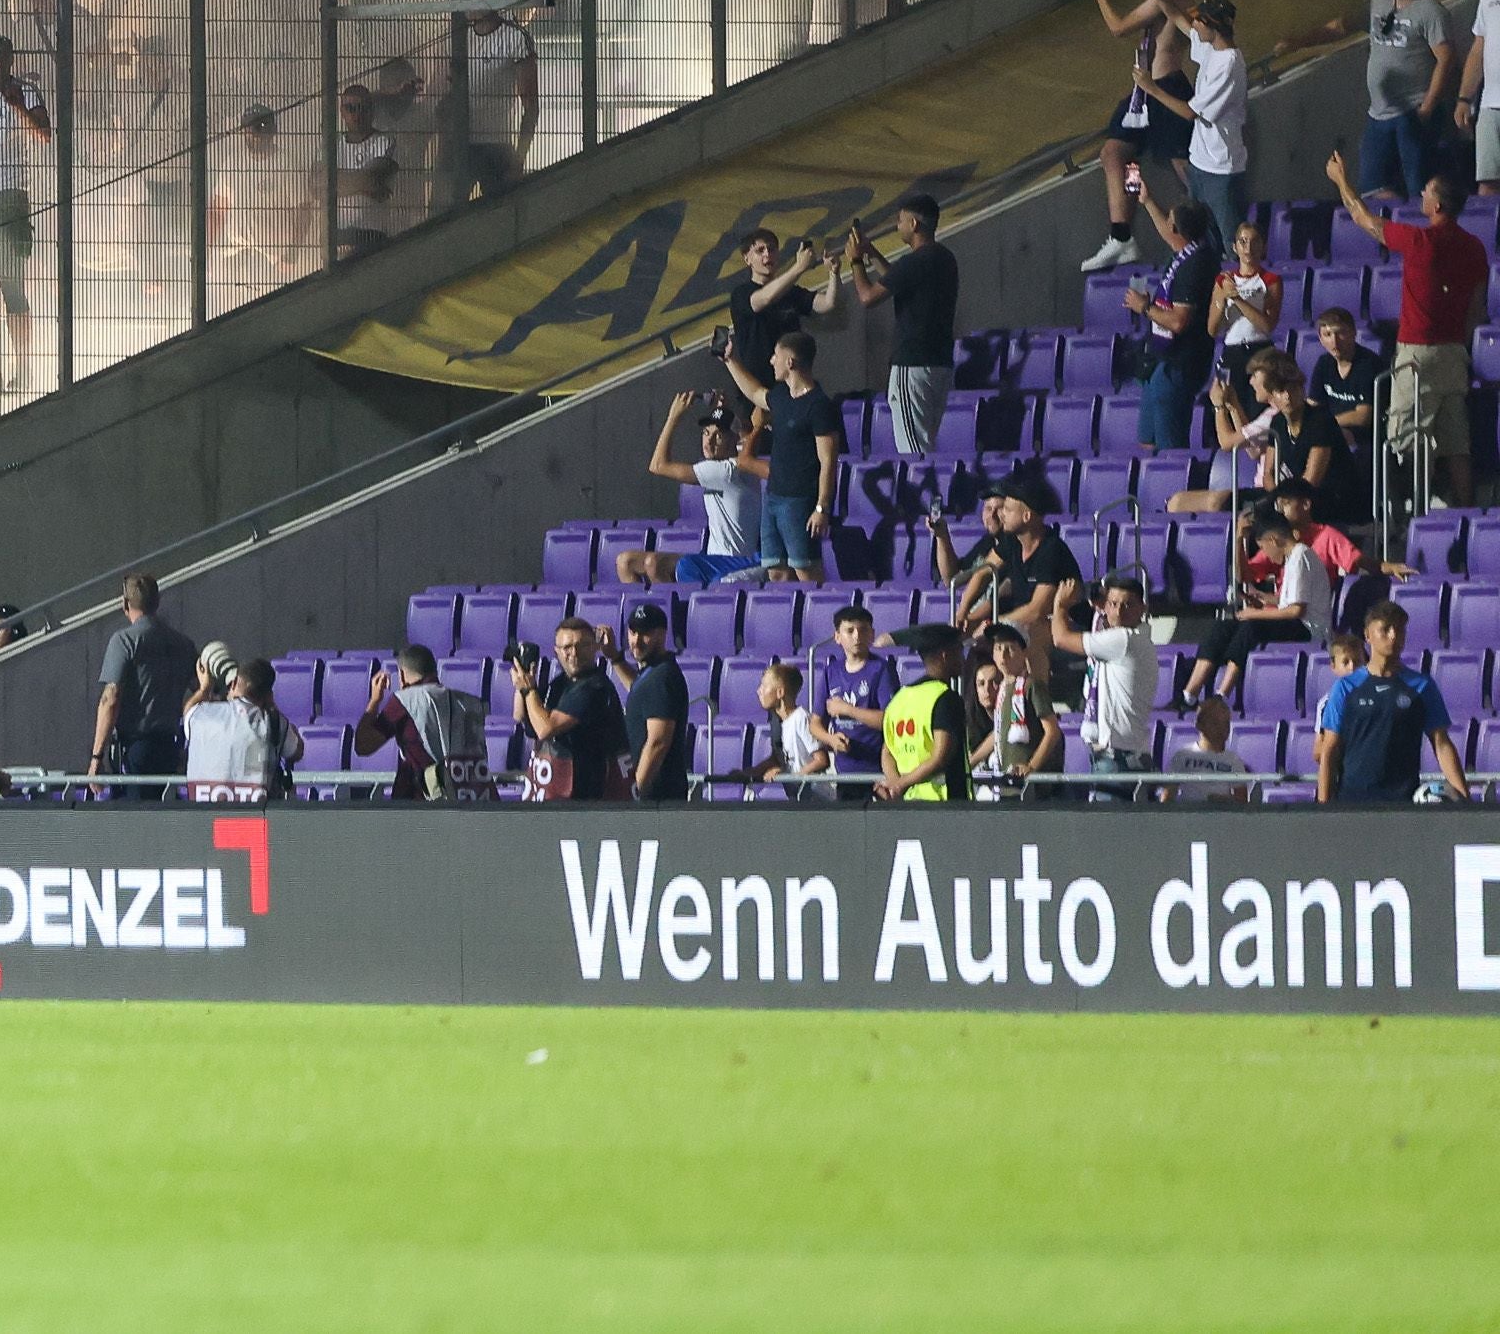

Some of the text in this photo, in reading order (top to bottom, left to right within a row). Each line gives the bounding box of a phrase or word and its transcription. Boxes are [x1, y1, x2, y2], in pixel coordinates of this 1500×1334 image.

[560, 839, 839, 982] Wenn
[873, 839, 1116, 986] Auto
[1150, 839, 1413, 988] dann
